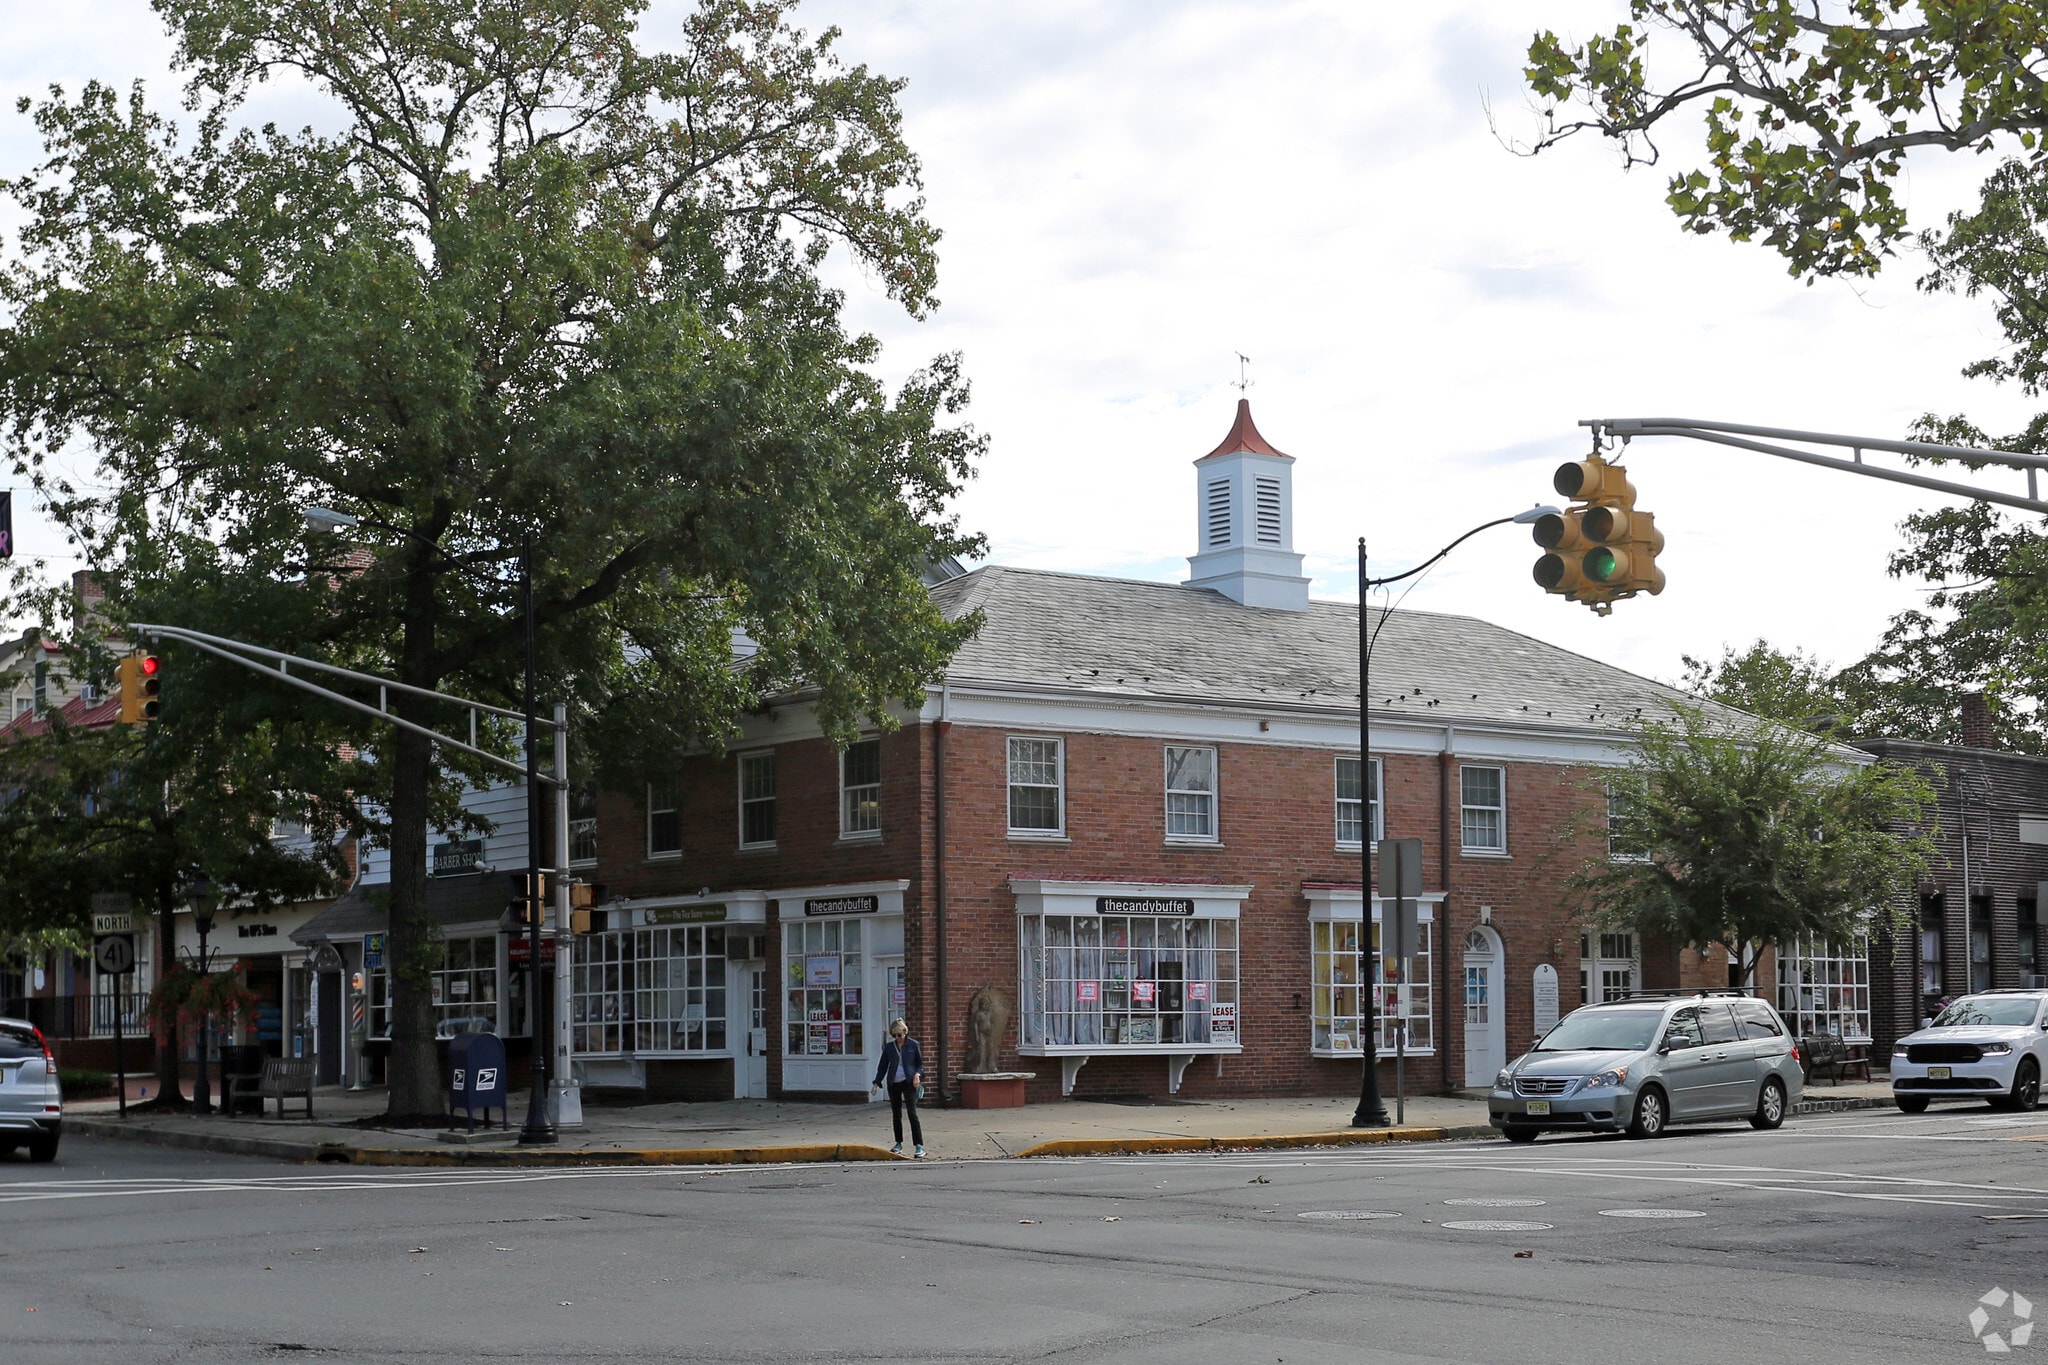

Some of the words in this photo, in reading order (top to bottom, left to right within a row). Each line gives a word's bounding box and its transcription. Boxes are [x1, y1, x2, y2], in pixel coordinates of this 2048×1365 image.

[434, 854, 461, 870] BARBER
[809, 897, 872, 914] thecandybuffet
[1104, 898, 1187, 914] thecandybuffet
[96, 916, 130, 931] NORTH
[104, 943, 123, 965] 41
[1543, 965, 1549, 973] 3
[810, 1012, 827, 1022] LEASE
[1212, 1006, 1234, 1016] LEASE
